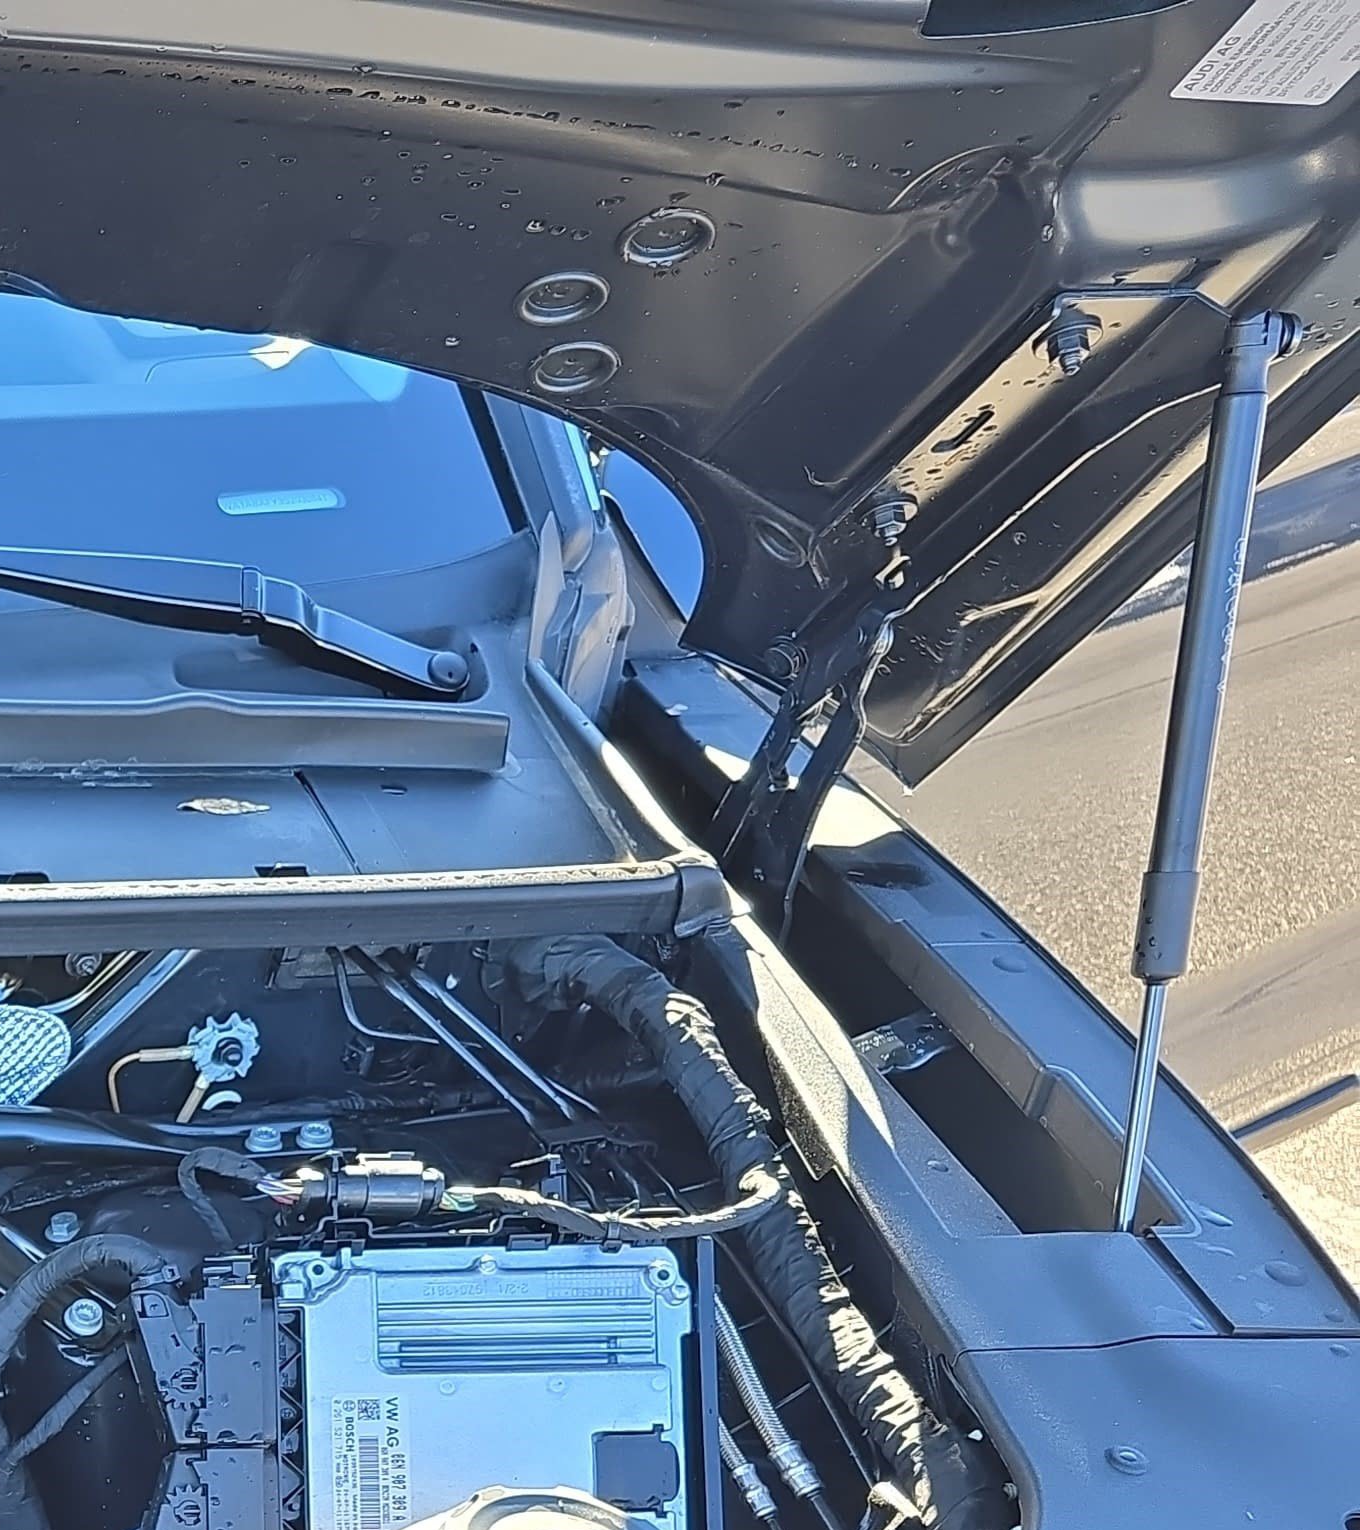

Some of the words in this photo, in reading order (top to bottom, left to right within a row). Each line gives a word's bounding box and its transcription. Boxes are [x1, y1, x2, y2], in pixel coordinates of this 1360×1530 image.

[1183, 59, 1219, 91] AUDI
[1216, 36, 1241, 56] AG
[1209, 57, 1248, 92] CONTROL
[1244, 1, 1300, 56] INFORMATION
[385, 1396, 398, 1421] VW
[344, 1416, 354, 1452] BOSCH
[385, 1426, 399, 1447] AG
